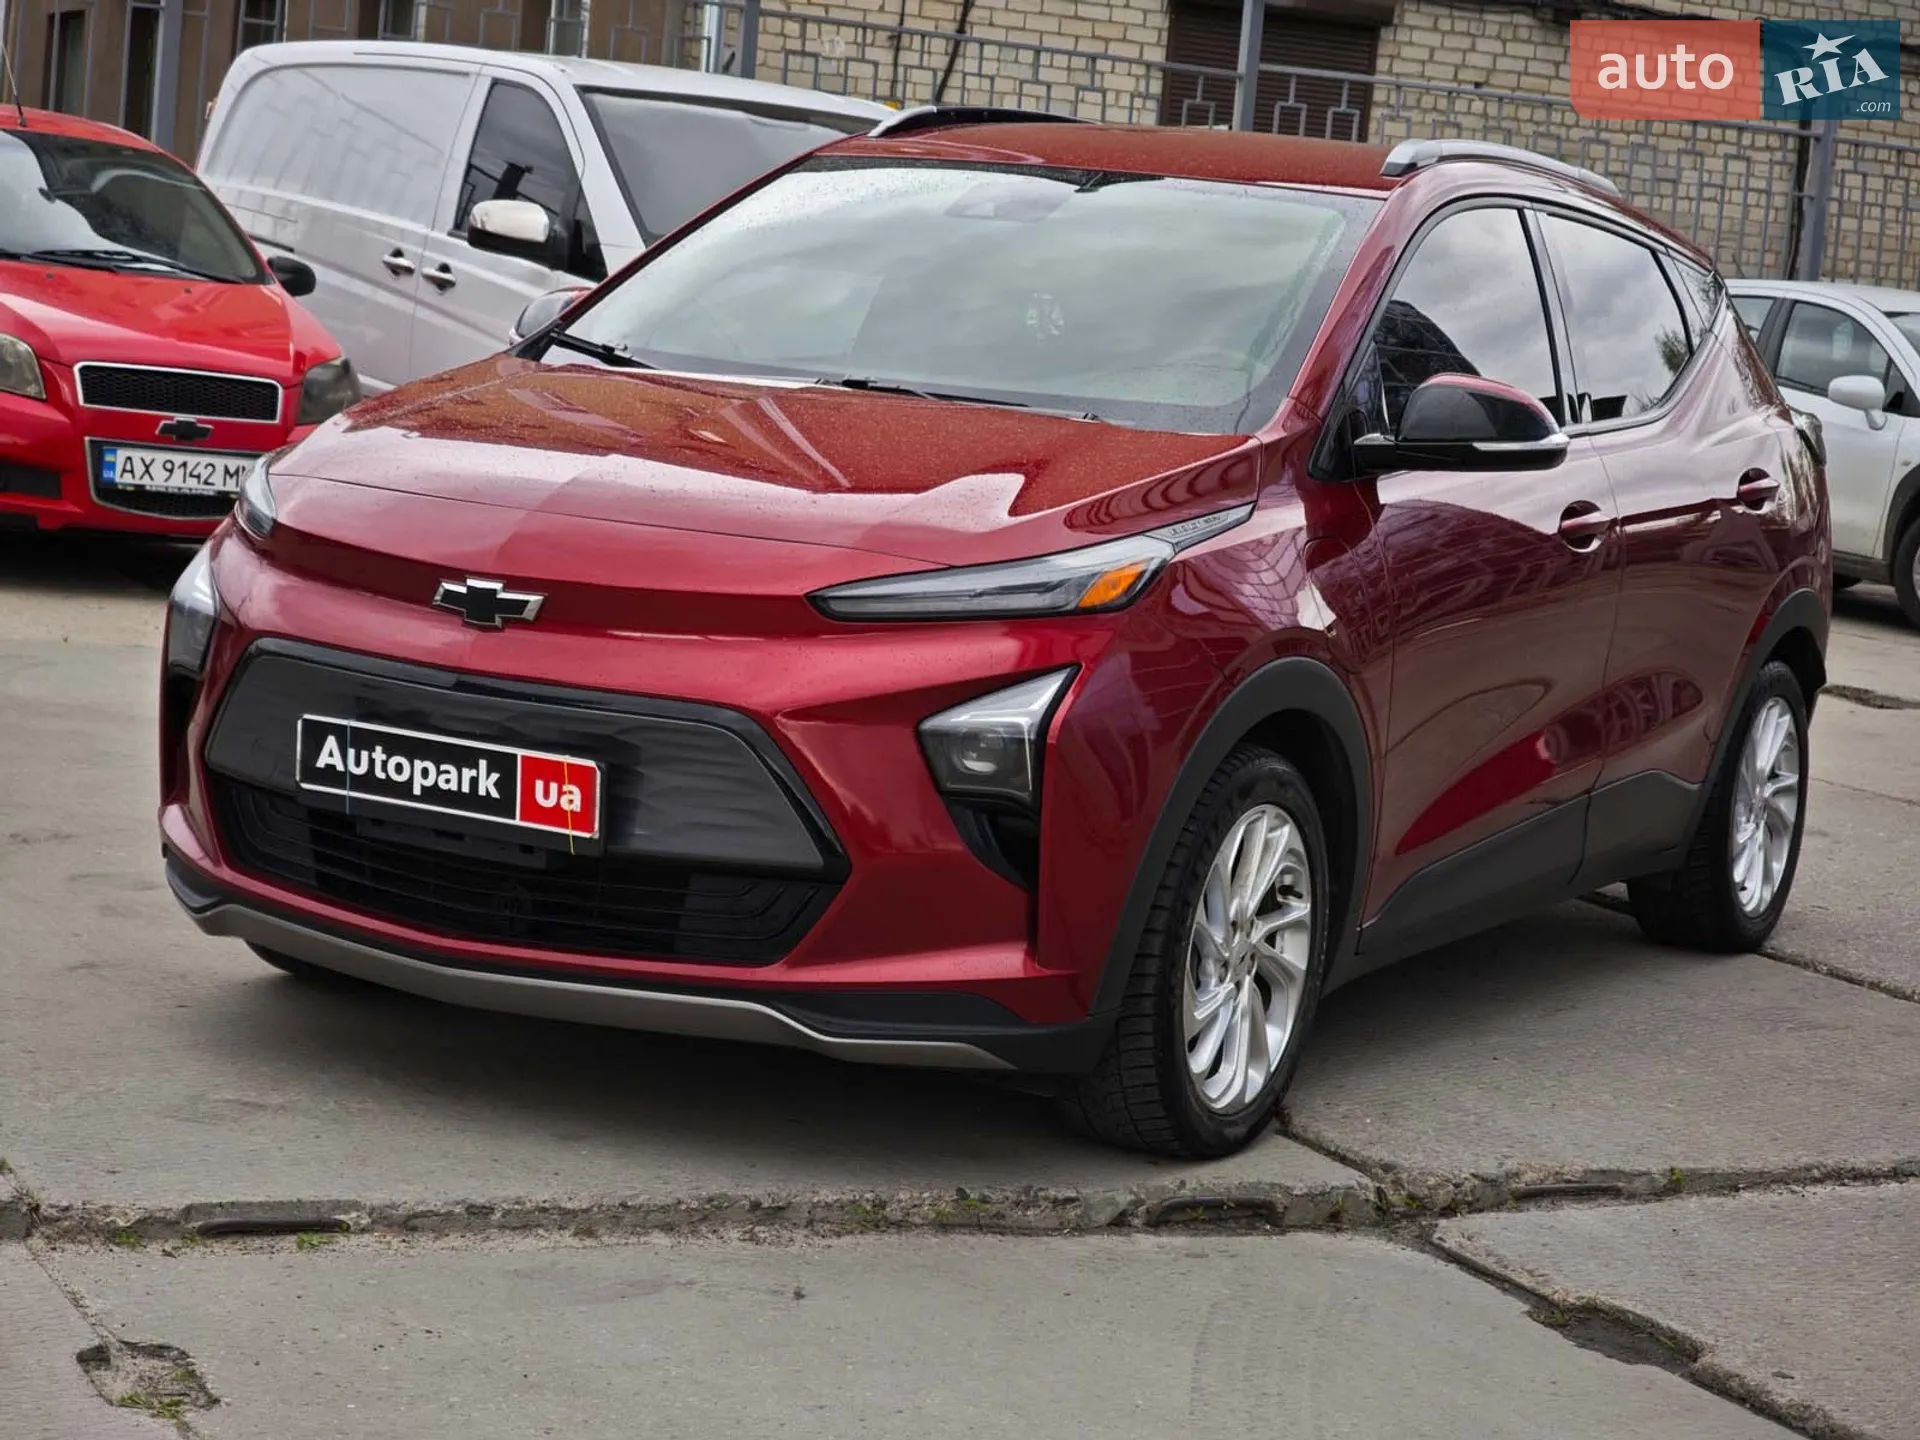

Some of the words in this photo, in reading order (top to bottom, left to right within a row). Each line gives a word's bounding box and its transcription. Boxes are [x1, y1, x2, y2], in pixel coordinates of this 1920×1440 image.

[119, 456, 155, 482] AX
[162, 458, 217, 487] 9142
[315, 734, 501, 799] Autopark
[534, 777, 581, 813] ua
